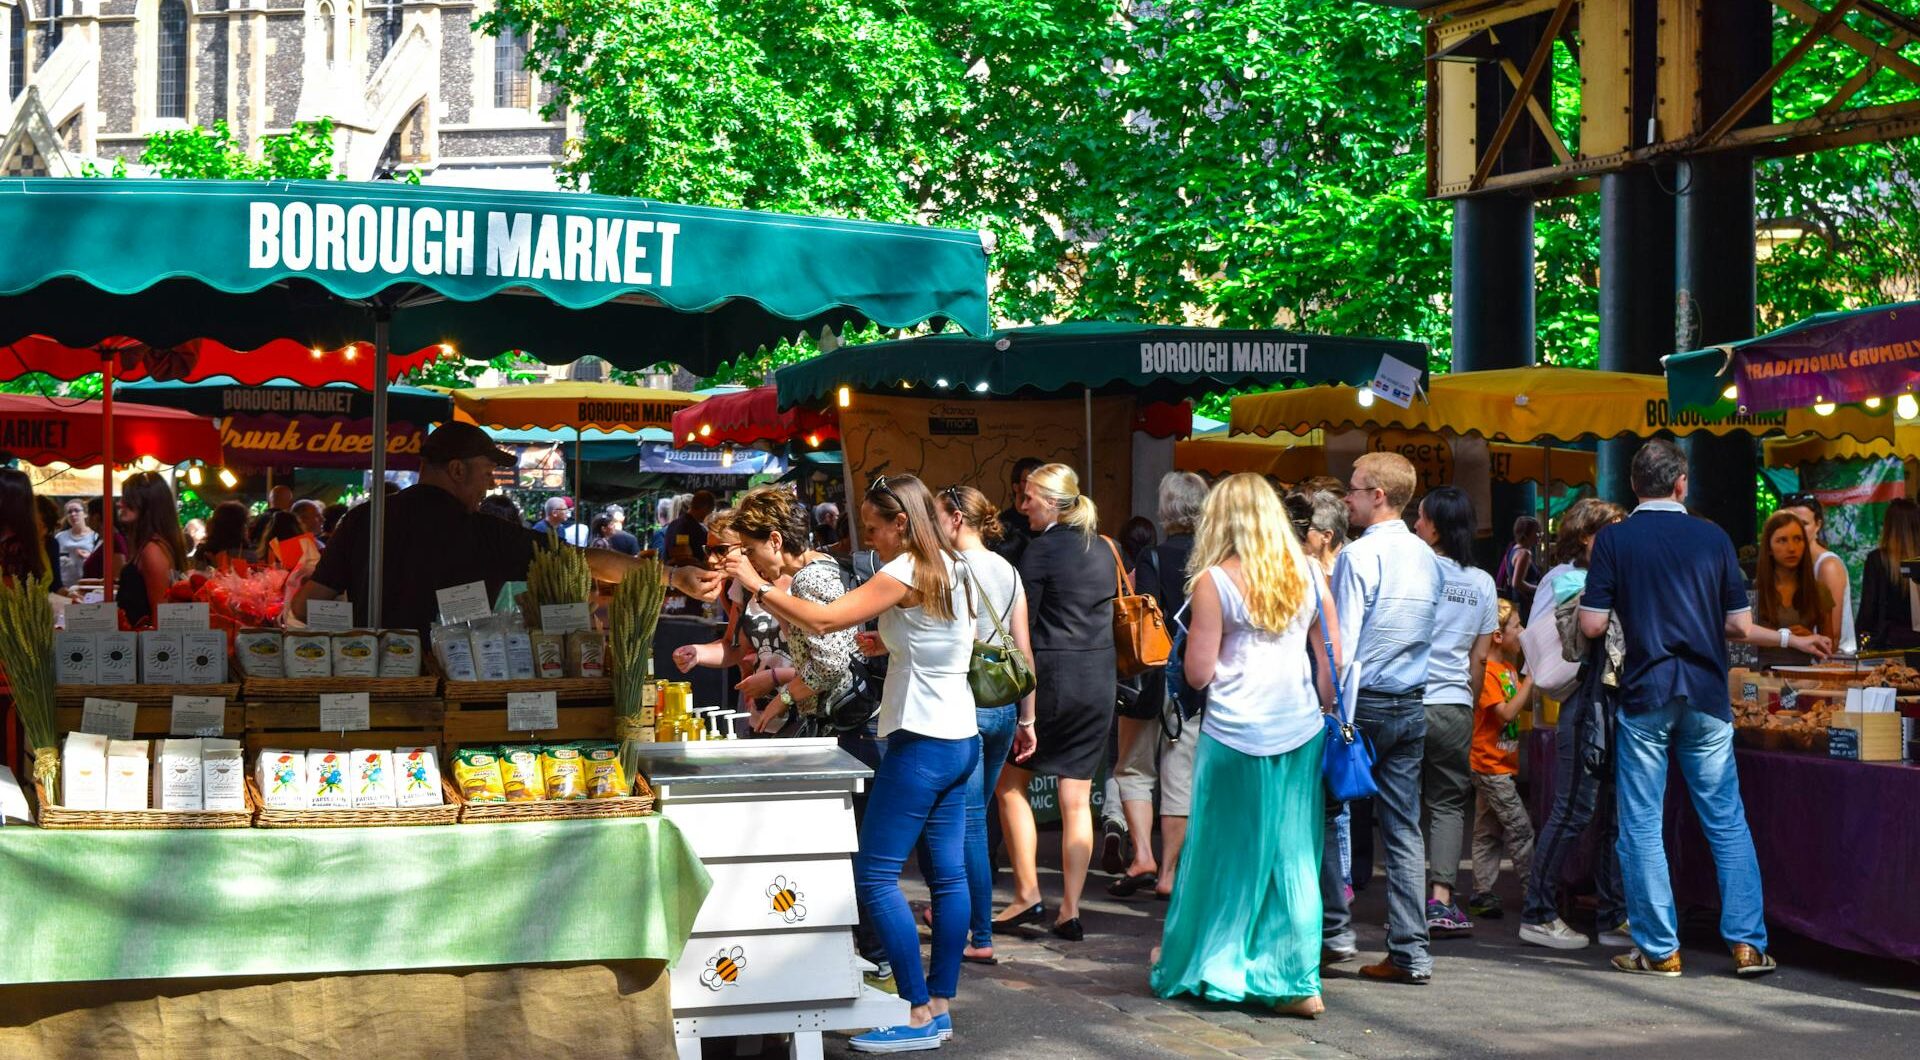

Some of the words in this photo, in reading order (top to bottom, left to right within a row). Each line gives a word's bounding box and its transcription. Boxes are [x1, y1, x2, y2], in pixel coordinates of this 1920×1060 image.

[249, 201, 475, 275] BOROUGH
[486, 212, 680, 286] MARKET
[1141, 342, 1228, 373] BOROUGH
[1232, 342, 1308, 373] MARKET
[1745, 352, 1848, 379] TRADITIONAL
[223, 389, 291, 411] BOROUGH
[293, 390, 354, 413] MARKET
[578, 401, 639, 422] BOROUGH
[642, 403, 691, 422] MAR
[0, 419, 70, 449] ARKET
[305, 422, 422, 454] cheees
[663, 449, 752, 464] pieminiter
